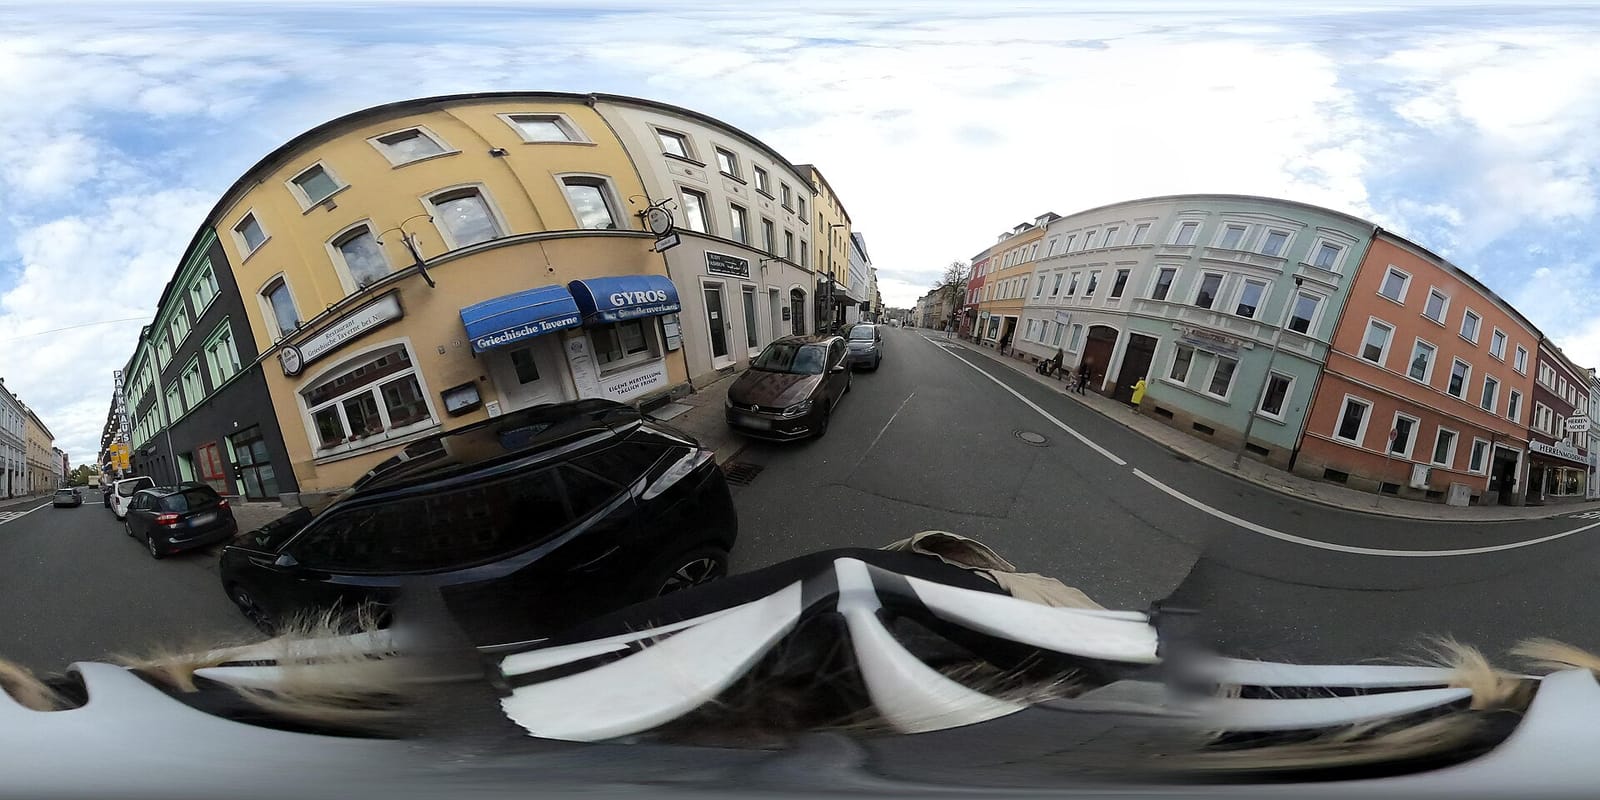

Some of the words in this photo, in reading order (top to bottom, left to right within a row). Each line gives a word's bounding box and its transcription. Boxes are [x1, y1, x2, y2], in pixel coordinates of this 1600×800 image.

[610, 289, 668, 307] GYROS
[307, 338, 336, 357] Griechische
[336, 325, 360, 340] Taverne
[361, 317, 371, 327] bei
[325, 320, 355, 338] Restaurant
[477, 326, 539, 348] Griechische
[539, 316, 578, 330] Taverne
[608, 382, 628, 393] EIGENE
[629, 371, 662, 385] HERSTELLUNG
[640, 378, 657, 387] FRISCH
[113, 370, 131, 442] PARKHAUS
